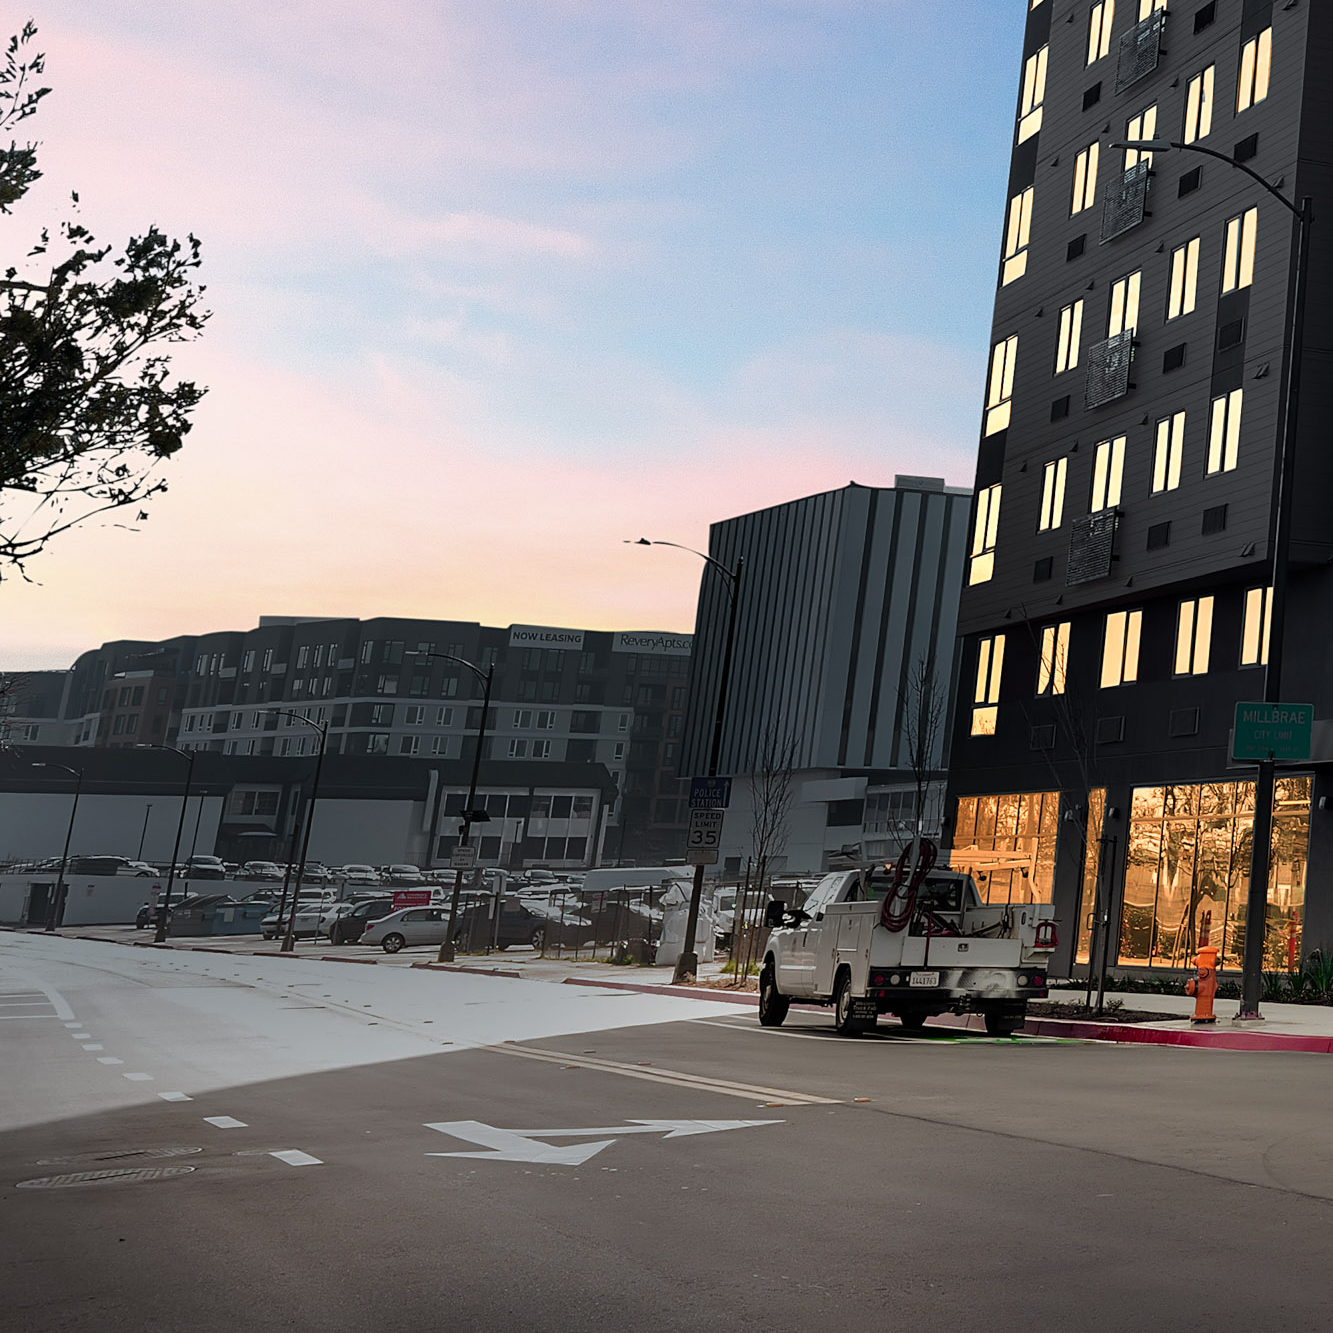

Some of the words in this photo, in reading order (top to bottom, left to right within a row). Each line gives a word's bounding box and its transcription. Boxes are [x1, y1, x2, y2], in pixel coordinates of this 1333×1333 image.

[513, 632, 537, 642] NOW
[540, 633, 581, 644] LEASING
[621, 634, 693, 652] ReveryApts.c
[1243, 710, 1306, 724] MILLBRAE
[1255, 730, 1272, 740] CITY
[694, 788, 721, 797] POLICE
[691, 798, 722, 807] STATION
[694, 812, 722, 820] SPEED
[691, 830, 716, 844] 35
